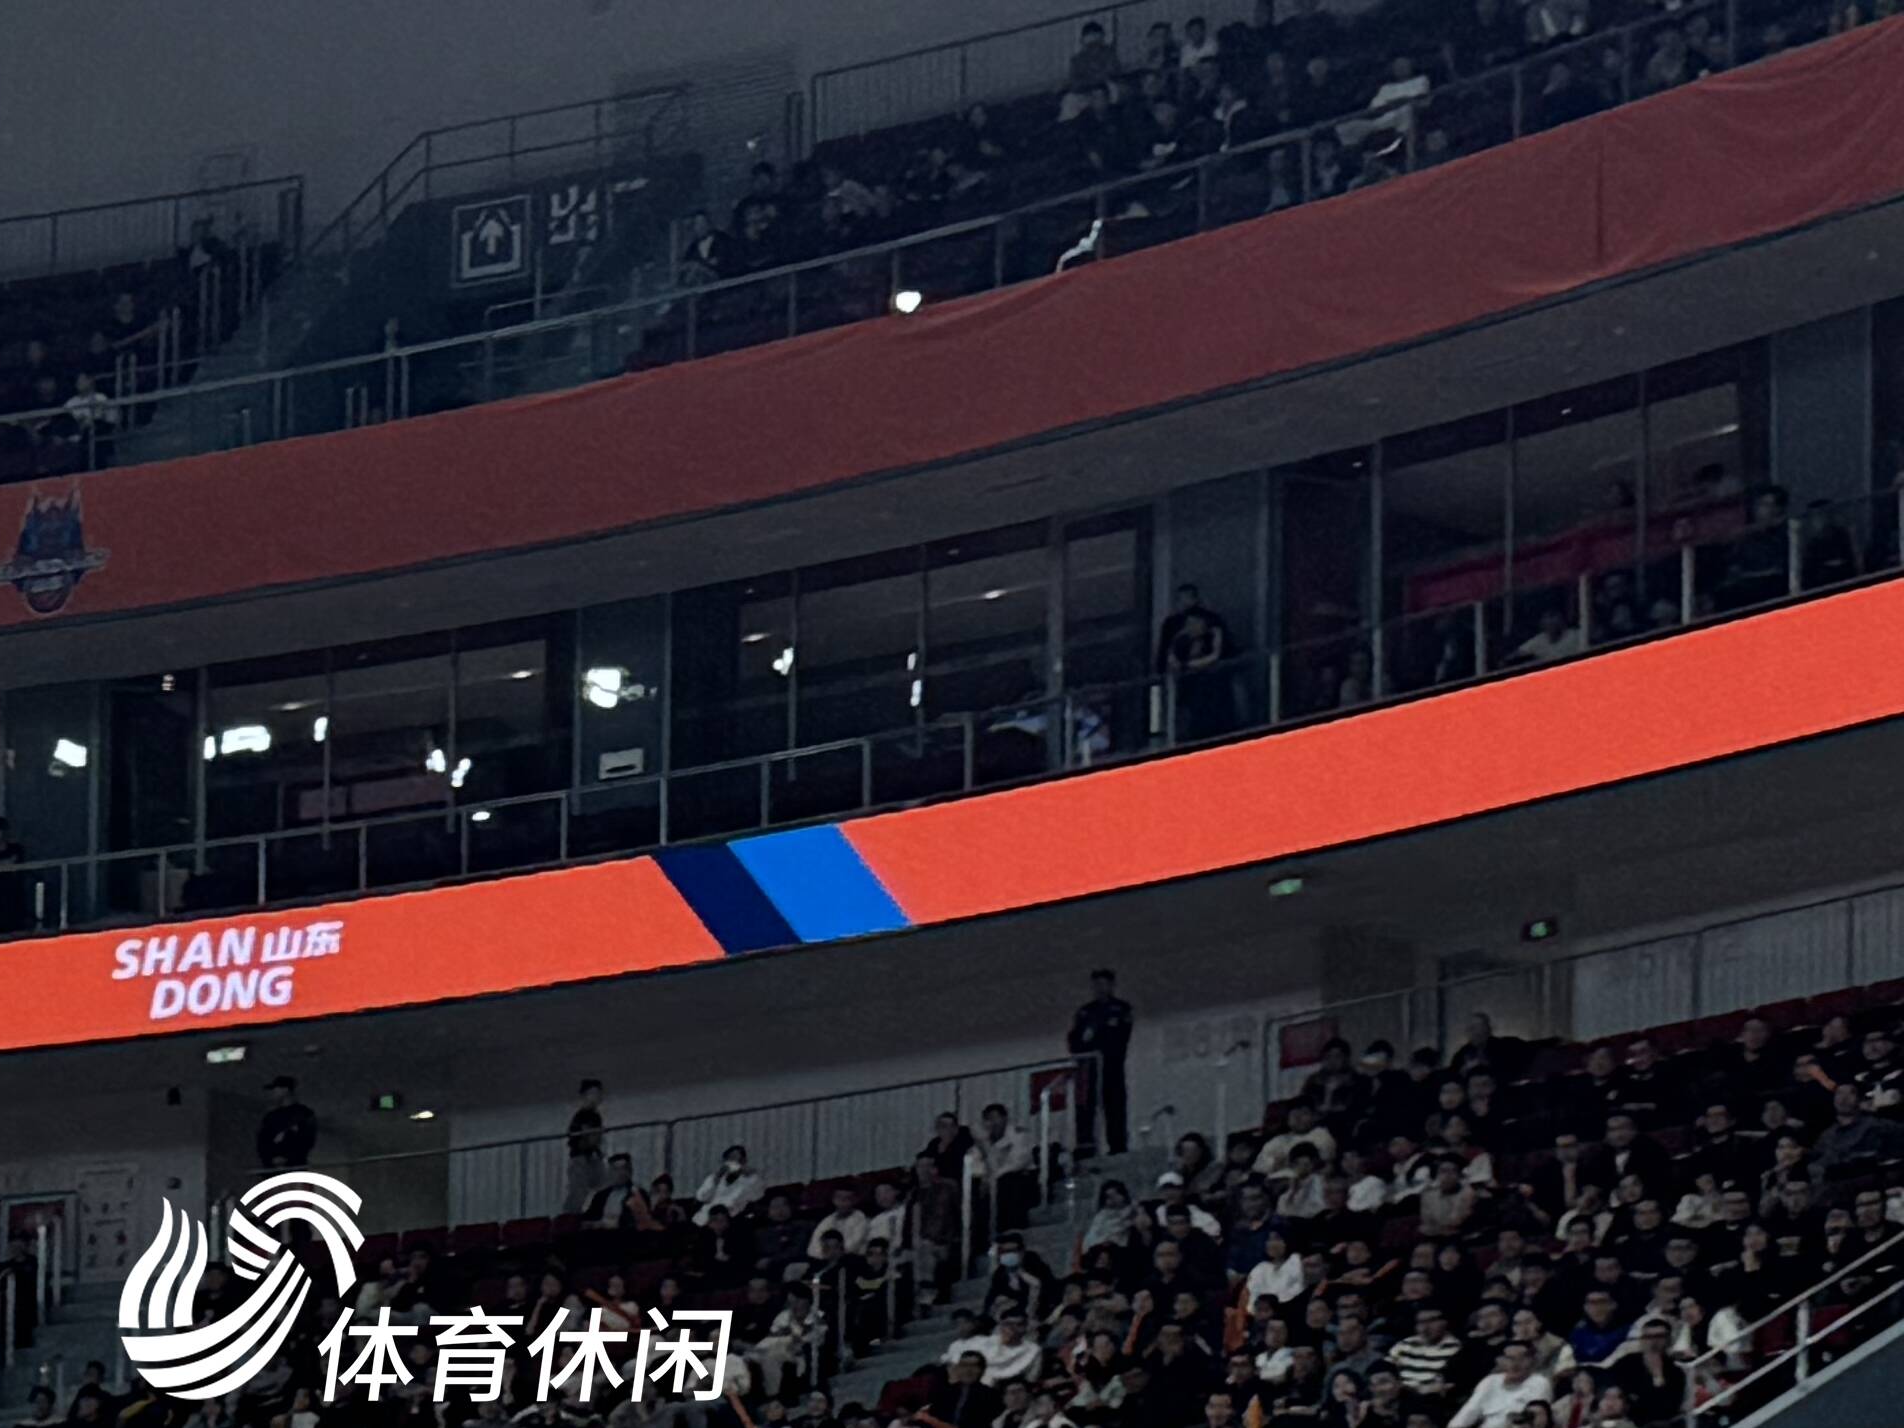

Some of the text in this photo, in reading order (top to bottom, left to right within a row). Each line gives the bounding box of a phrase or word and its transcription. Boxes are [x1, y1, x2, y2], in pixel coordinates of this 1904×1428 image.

[111, 920, 344, 980] SHAN 山东
[149, 965, 295, 1020] DONG
